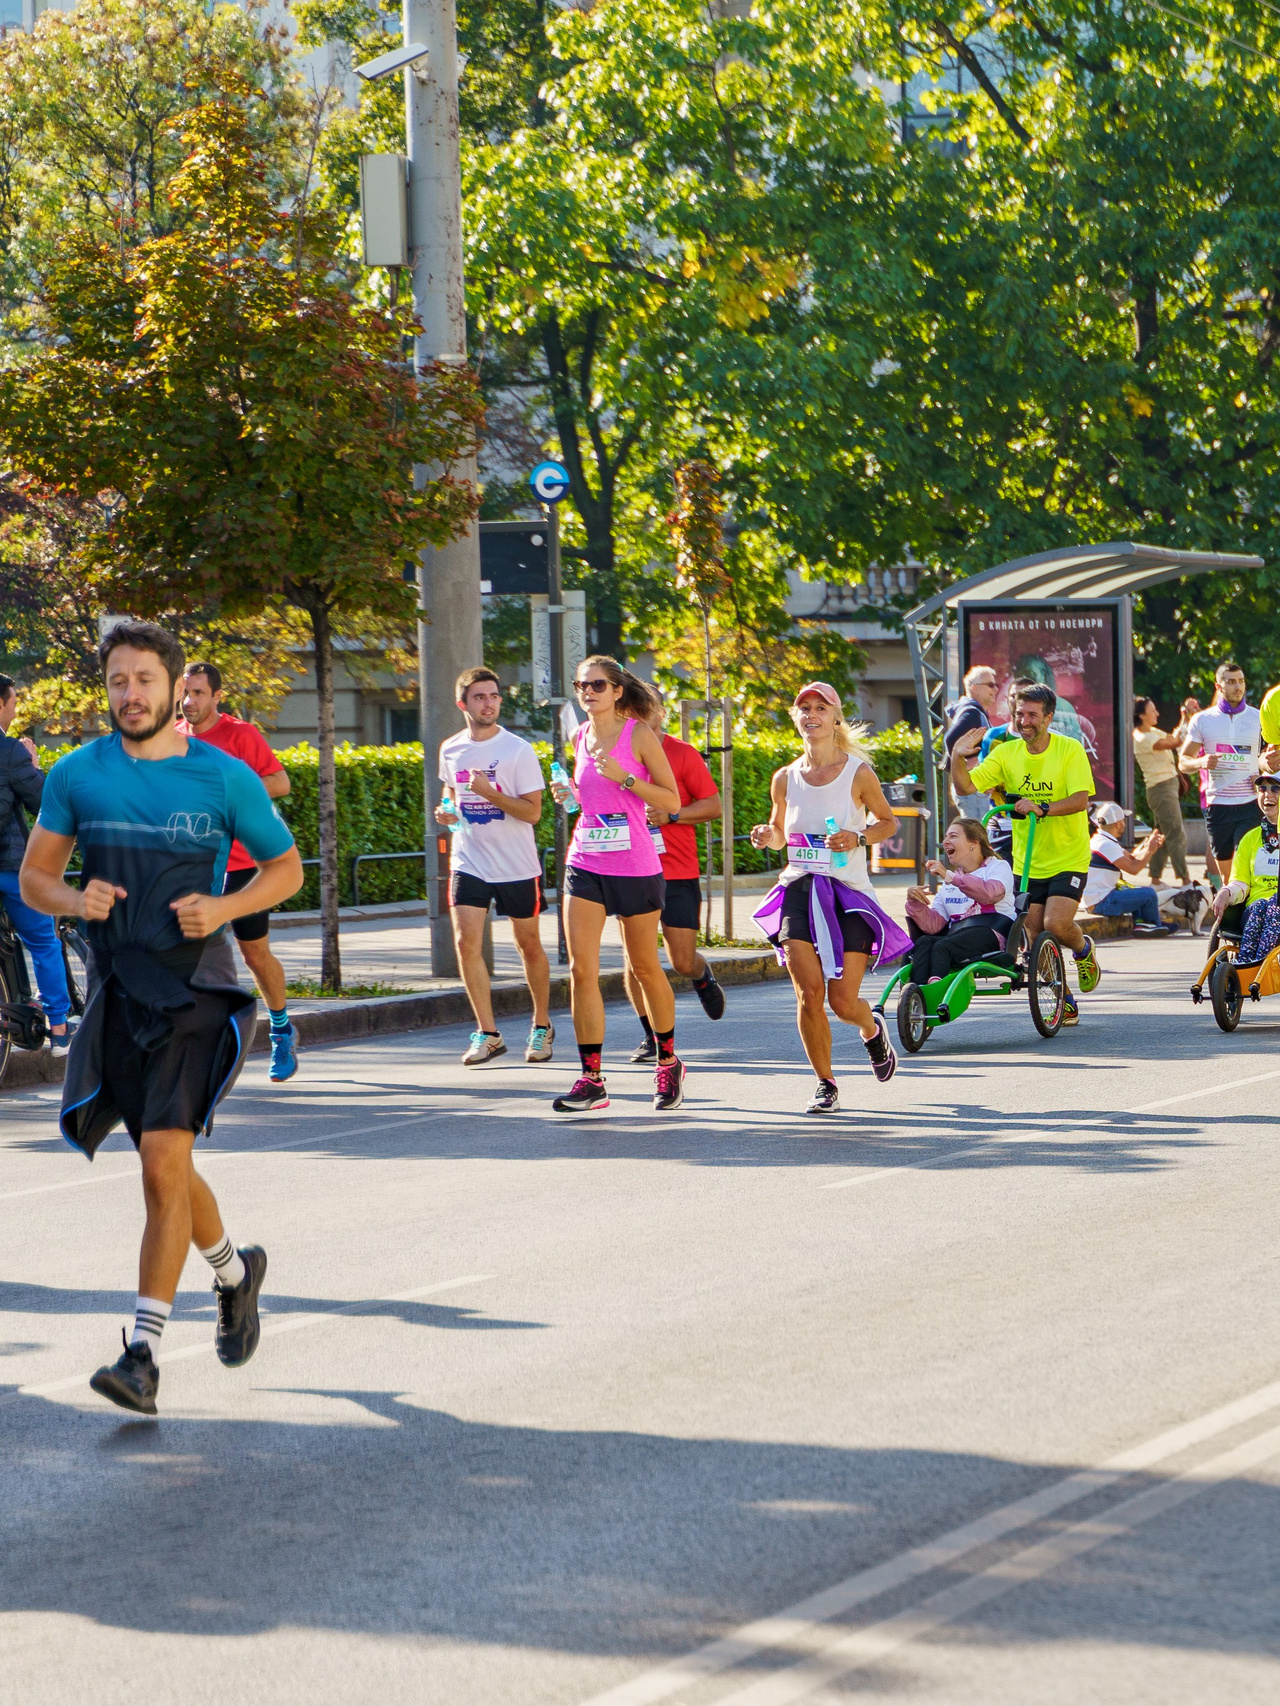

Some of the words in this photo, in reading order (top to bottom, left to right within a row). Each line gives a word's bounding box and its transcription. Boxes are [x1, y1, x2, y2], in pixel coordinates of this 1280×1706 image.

[979, 621, 985, 631] В
[988, 621, 1025, 631] КИНАТА
[1028, 620, 1040, 630] ОТ
[1044, 620, 1056, 630] 10
[1060, 618, 1103, 628] НОЕМВРИ
[1032, 782, 1053, 791] UN
[588, 828, 619, 839] 4727
[796, 848, 819, 859] 4161
